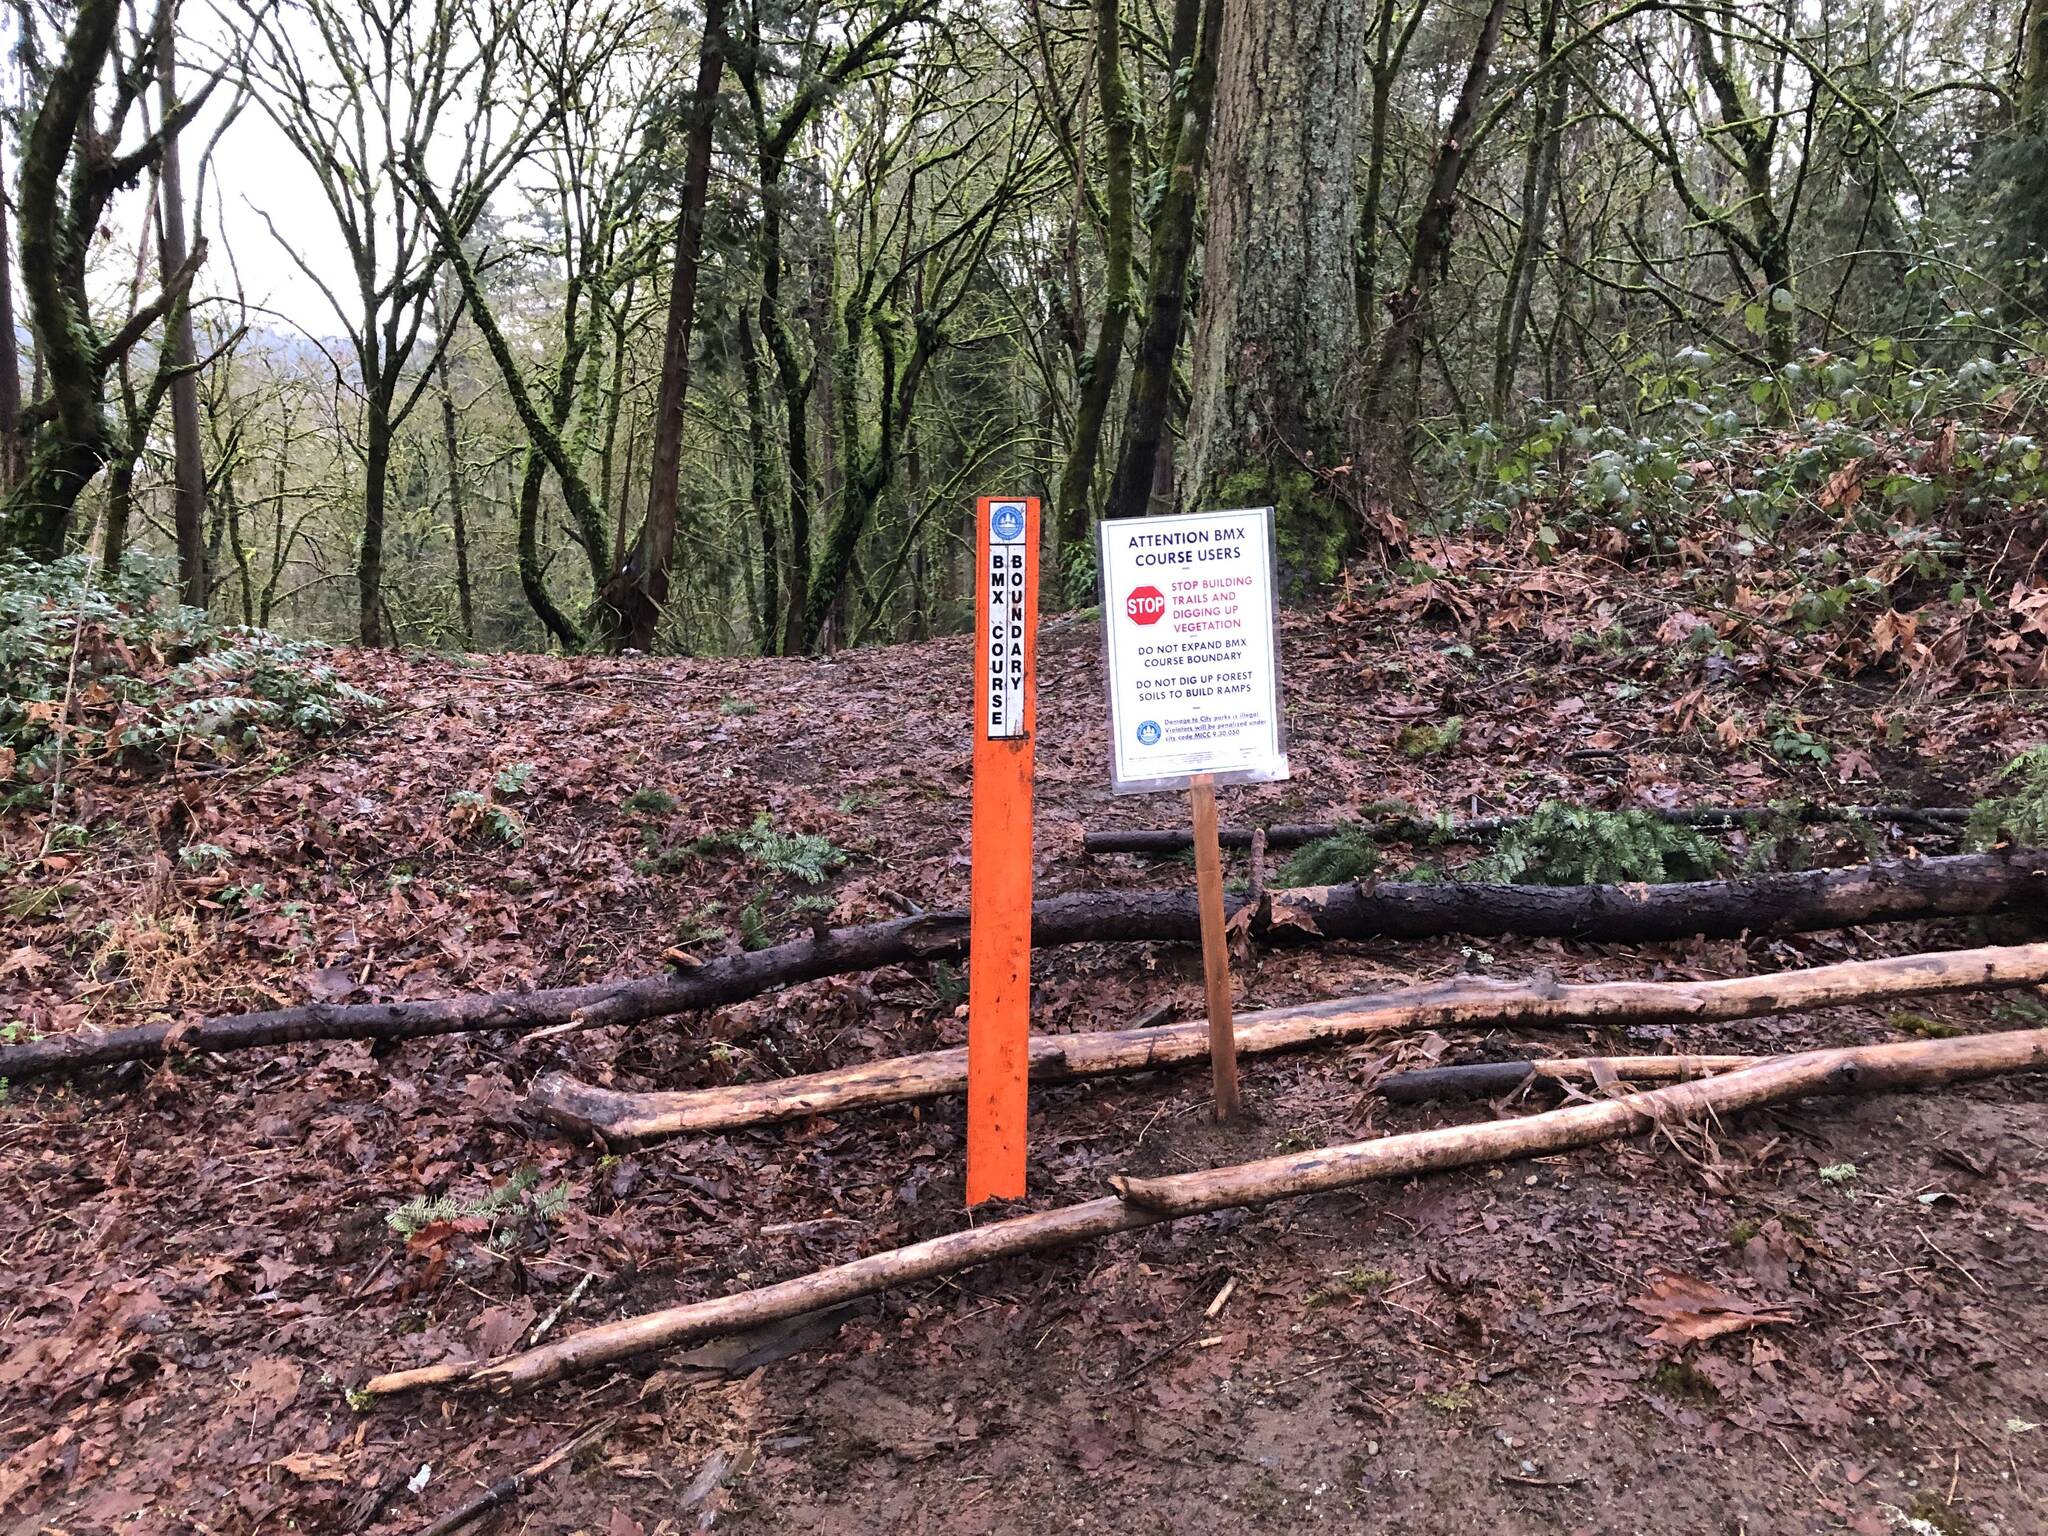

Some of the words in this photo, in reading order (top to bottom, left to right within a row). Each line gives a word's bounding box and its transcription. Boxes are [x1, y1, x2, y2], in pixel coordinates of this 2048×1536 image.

[1128, 531, 1209, 548] ATTENTION
[1214, 528, 1245, 541] BMX
[1135, 551, 1193, 566] COURSE
[1198, 547, 1241, 561] USERS
[991, 555, 1005, 604] BMX
[1171, 580, 1198, 591] STOP
[1202, 576, 1253, 589] BUILDING
[1127, 596, 1164, 615] STOP
[1172, 593, 1208, 605] TRAILS
[1212, 591, 1236, 601] AND
[1173, 606, 1221, 619] DIGGING
[1225, 605, 1239, 615] UP
[1011, 555, 1023, 690] BOUNDARY
[1174, 619, 1241, 633] VEGETATION
[1138, 646, 1153, 655] DO
[1157, 644, 1178, 654] NOT
[1182, 640, 1222, 652] EXPAND
[1225, 638, 1247, 648] BMX
[1144, 656, 1184, 667] COURSE
[1187, 651, 1242, 664] BOUNDARY
[991, 625, 1003, 725] COURSE
[1136, 680, 1151, 689] DO
[1155, 678, 1176, 688] NOT
[1180, 676, 1197, 686] DIG
[1200, 674, 1213, 684] UP
[1216, 671, 1253, 682] FOREST
[1139, 691, 1166, 701] SOILS
[1169, 690, 1182, 699] TO
[1186, 687, 1213, 698] BUILD
[1217, 684, 1251, 695] RAMPS
[1200, 715, 1212, 723] City
